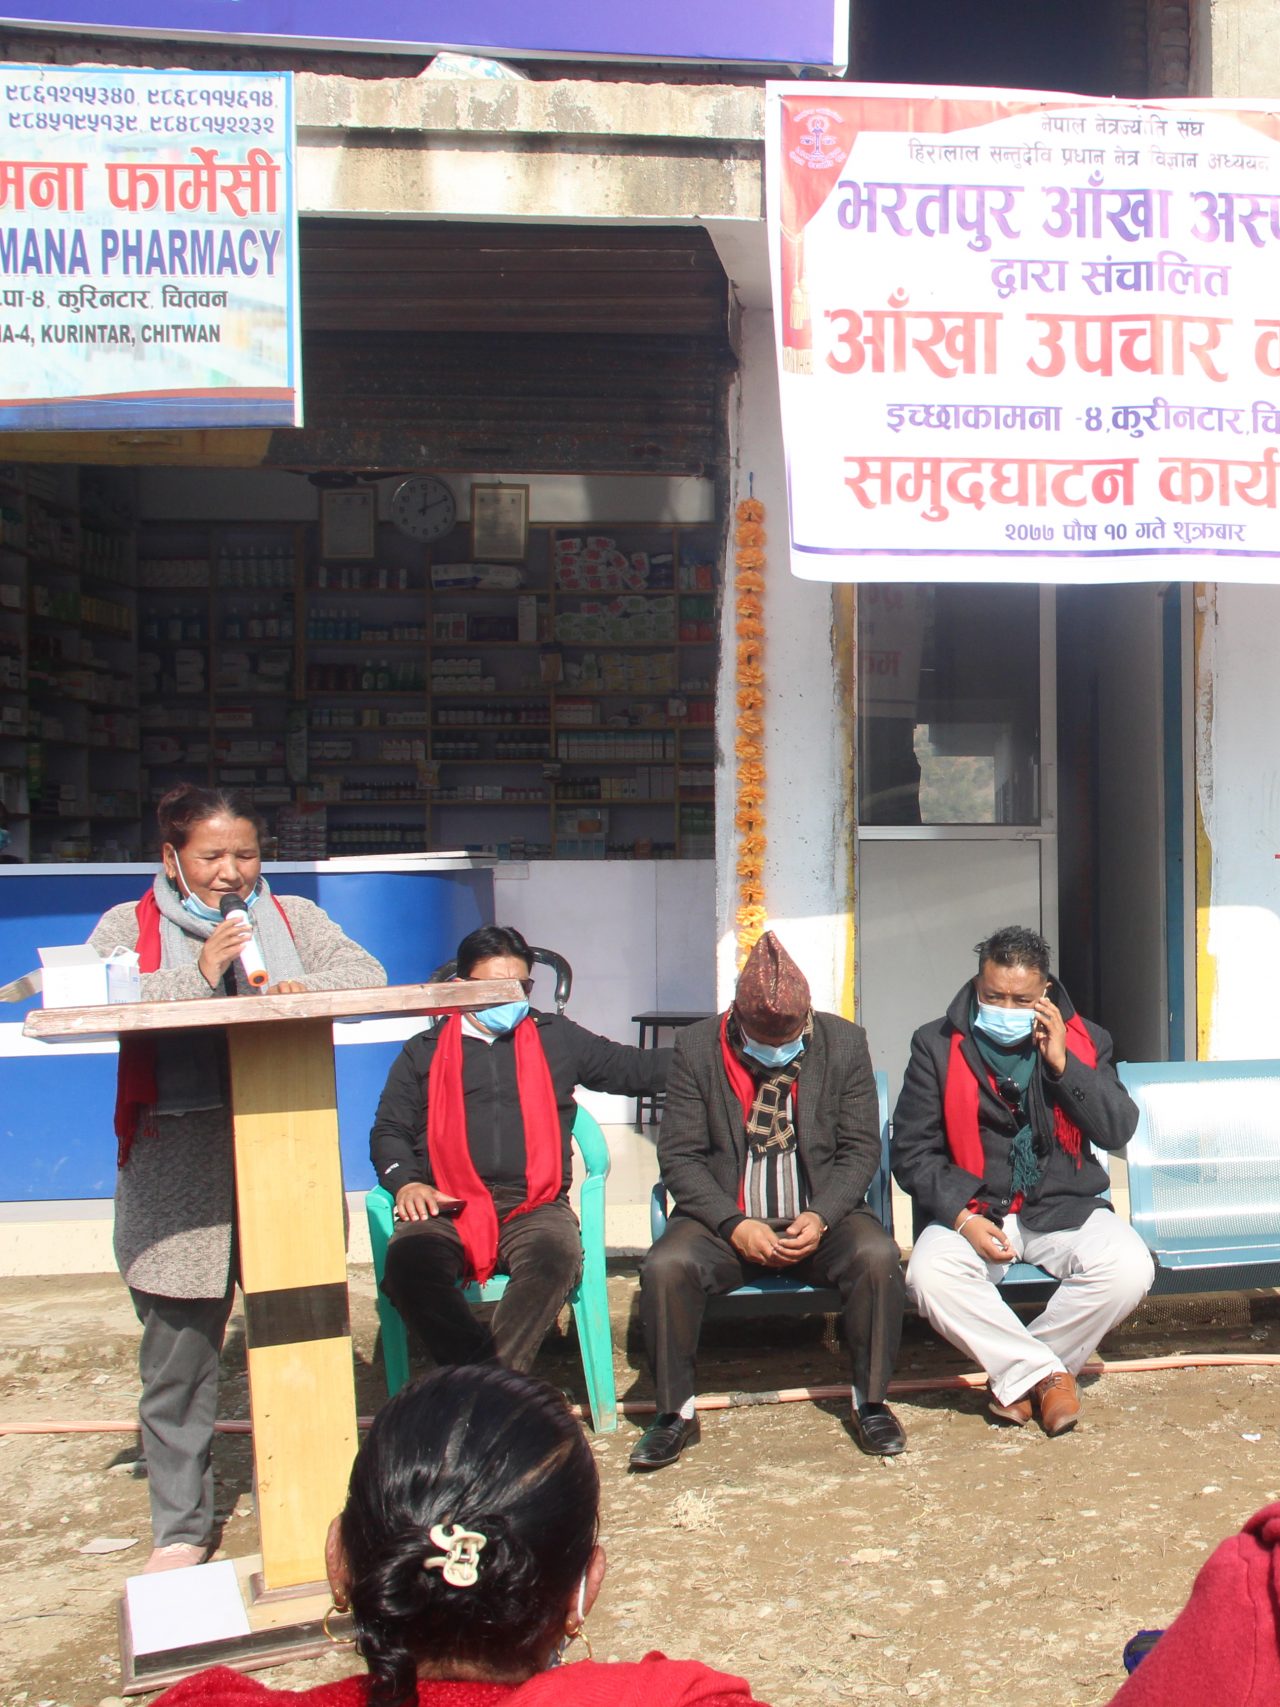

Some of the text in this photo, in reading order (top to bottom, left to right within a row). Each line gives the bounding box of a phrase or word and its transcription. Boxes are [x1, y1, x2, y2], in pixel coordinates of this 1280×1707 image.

[1176, 118, 1205, 139] संघ
[908, 138, 981, 164] हिरालाल
[1061, 148, 1106, 166] प्रधान
[1114, 145, 1141, 166] नेत्र
[1149, 145, 1199, 170] विज्ञान
[105, 147, 282, 218] फार्मेसी
[836, 178, 1024, 252] भरतपुर
[1043, 168, 1170, 243] आँखा
[102, 229, 282, 277] PHARMACY
[990, 249, 1232, 300] द्वारा संचालित
[162, 285, 229, 309] चितवन
[41, 324, 136, 347] KURINTAR,
[141, 324, 221, 343] CHITWAN
[825, 288, 1003, 382] आँखा
[1026, 313, 1234, 383] उपचार
[886, 403, 1063, 433] इच्छाकामना
[1005, 517, 1247, 544] २०७७ पौष १० गते शुक्रबार
